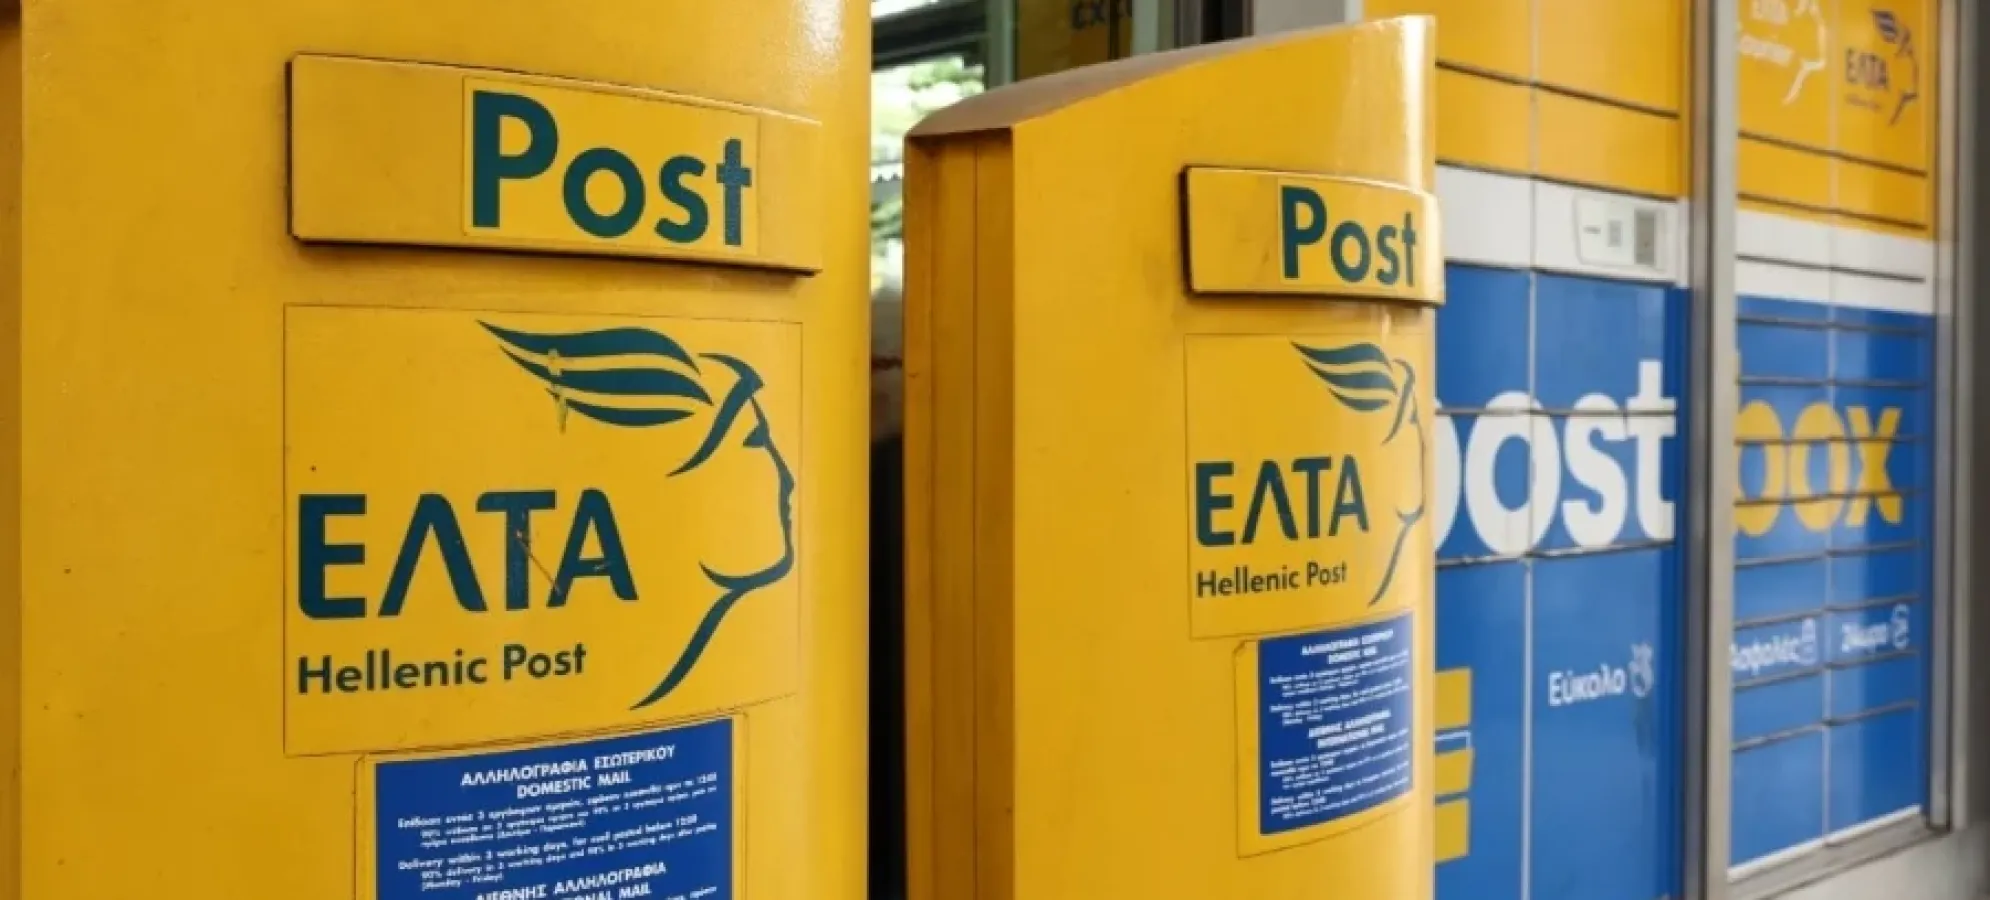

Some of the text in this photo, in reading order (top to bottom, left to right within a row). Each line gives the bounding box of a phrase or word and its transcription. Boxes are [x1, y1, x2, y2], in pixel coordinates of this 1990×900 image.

[472, 90, 752, 247] Post
[1280, 185, 1416, 287] Post
[1195, 453, 1369, 547] ΕΛΤΑ
[298, 487, 639, 620] ΕΛΤΑ
[1196, 561, 1348, 598] Hellenic Post
[298, 643, 587, 695] Hellenic Post
[1548, 663, 1627, 707] Εύκολο
[460, 744, 676, 787] ΑΛΛΗΛΟΓΡΑΦΙΑ ΕΣΩΤΕΡΙΚΟΥ
[516, 770, 633, 799] DOMESTIC MAIL
[553, 861, 667, 896] ΑΛΛΗΛΟΓΡΑΦΙΑ
[619, 882, 652, 899] MAIL
